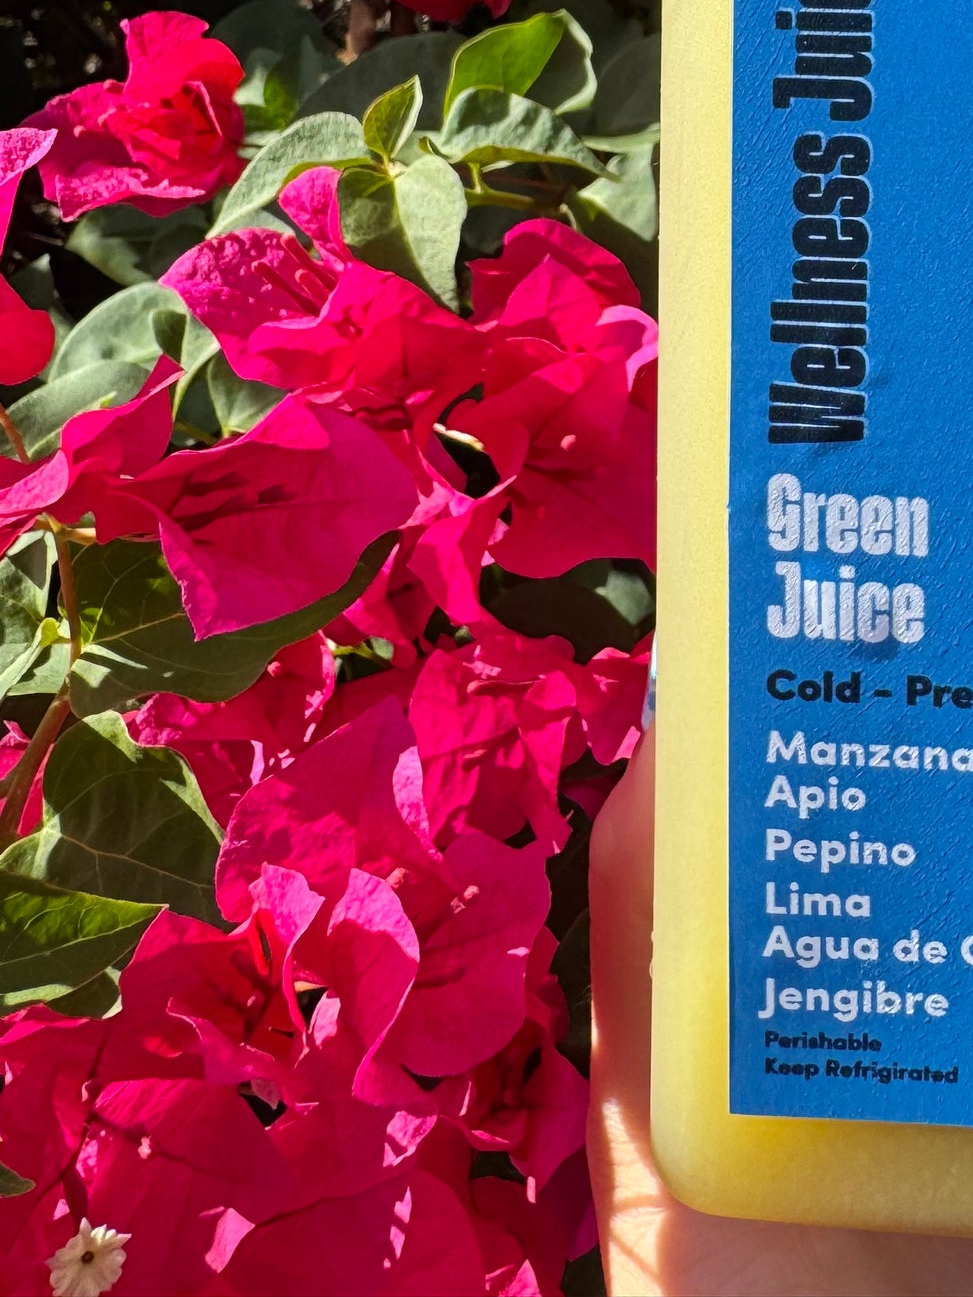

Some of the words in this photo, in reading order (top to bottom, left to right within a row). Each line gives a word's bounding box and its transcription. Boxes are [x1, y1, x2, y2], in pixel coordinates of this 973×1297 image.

[767, 133, 872, 444] Wellness
[766, 472, 930, 558] Green
[766, 560, 925, 644] Juice
[766, 669, 861, 704] Cold
[764, 775, 867, 820] Apio
[765, 828, 917, 874] Pepino
[765, 882, 871, 918] Lima
[762, 926, 879, 968] Agua
[892, 930, 948, 965] de
[757, 978, 949, 1023] Jengibre
[764, 1031, 883, 1052] Perishable
[764, 1058, 820, 1080] Keep
[825, 1059, 959, 1085] Refrigirated
